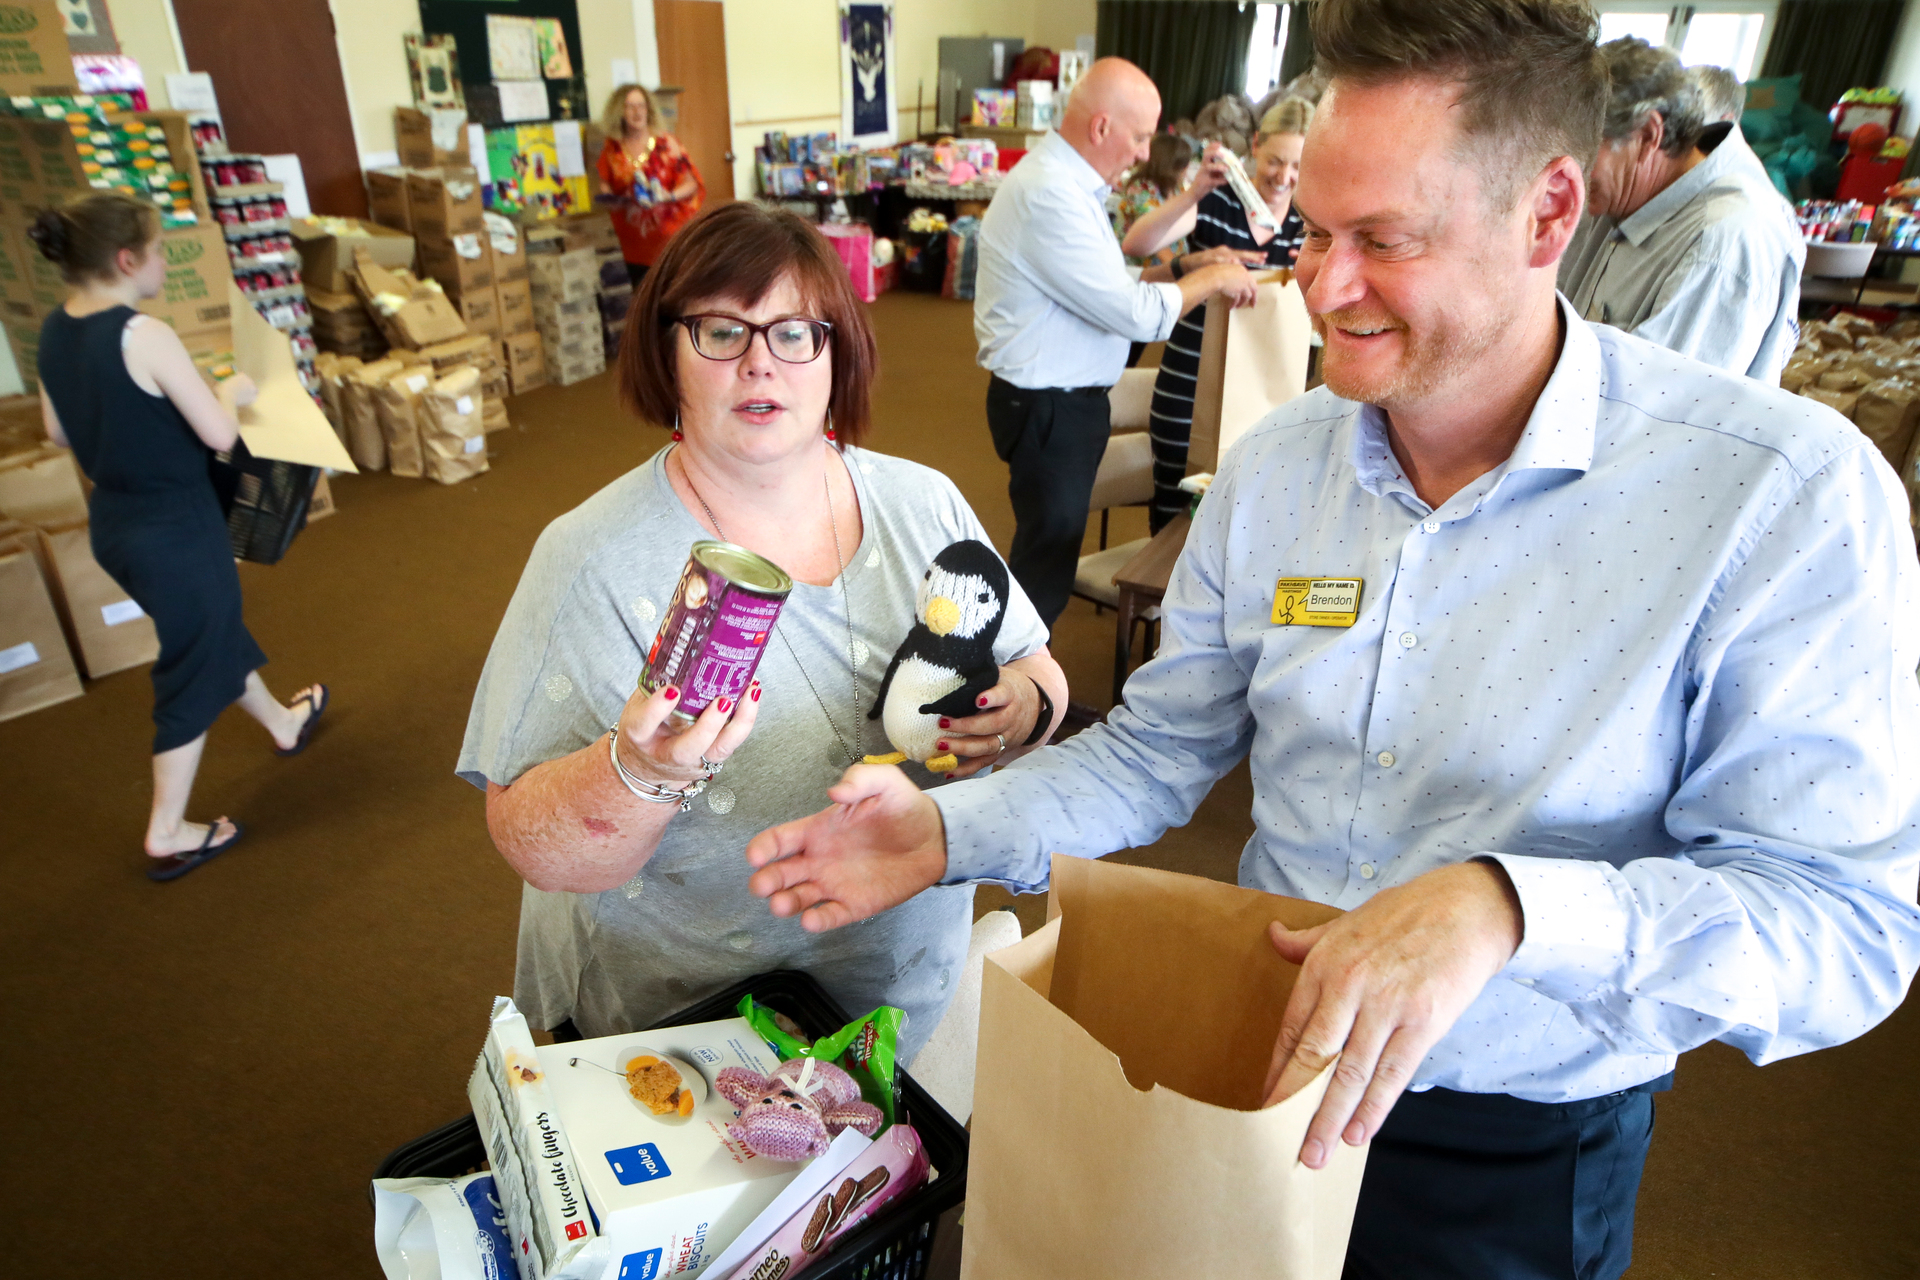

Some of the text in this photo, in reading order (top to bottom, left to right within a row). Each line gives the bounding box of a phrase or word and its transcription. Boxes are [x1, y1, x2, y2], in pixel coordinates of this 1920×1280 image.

[1311, 595, 1352, 605] Brendon
[697, 1049, 715, 1063] NEW
[536, 1111, 578, 1218] Chocolate fingers
[638, 1148, 659, 1175] value
[675, 1236, 694, 1275] WHEAT
[687, 1222, 708, 1271] BISCUITS
[641, 1252, 655, 1280] value
